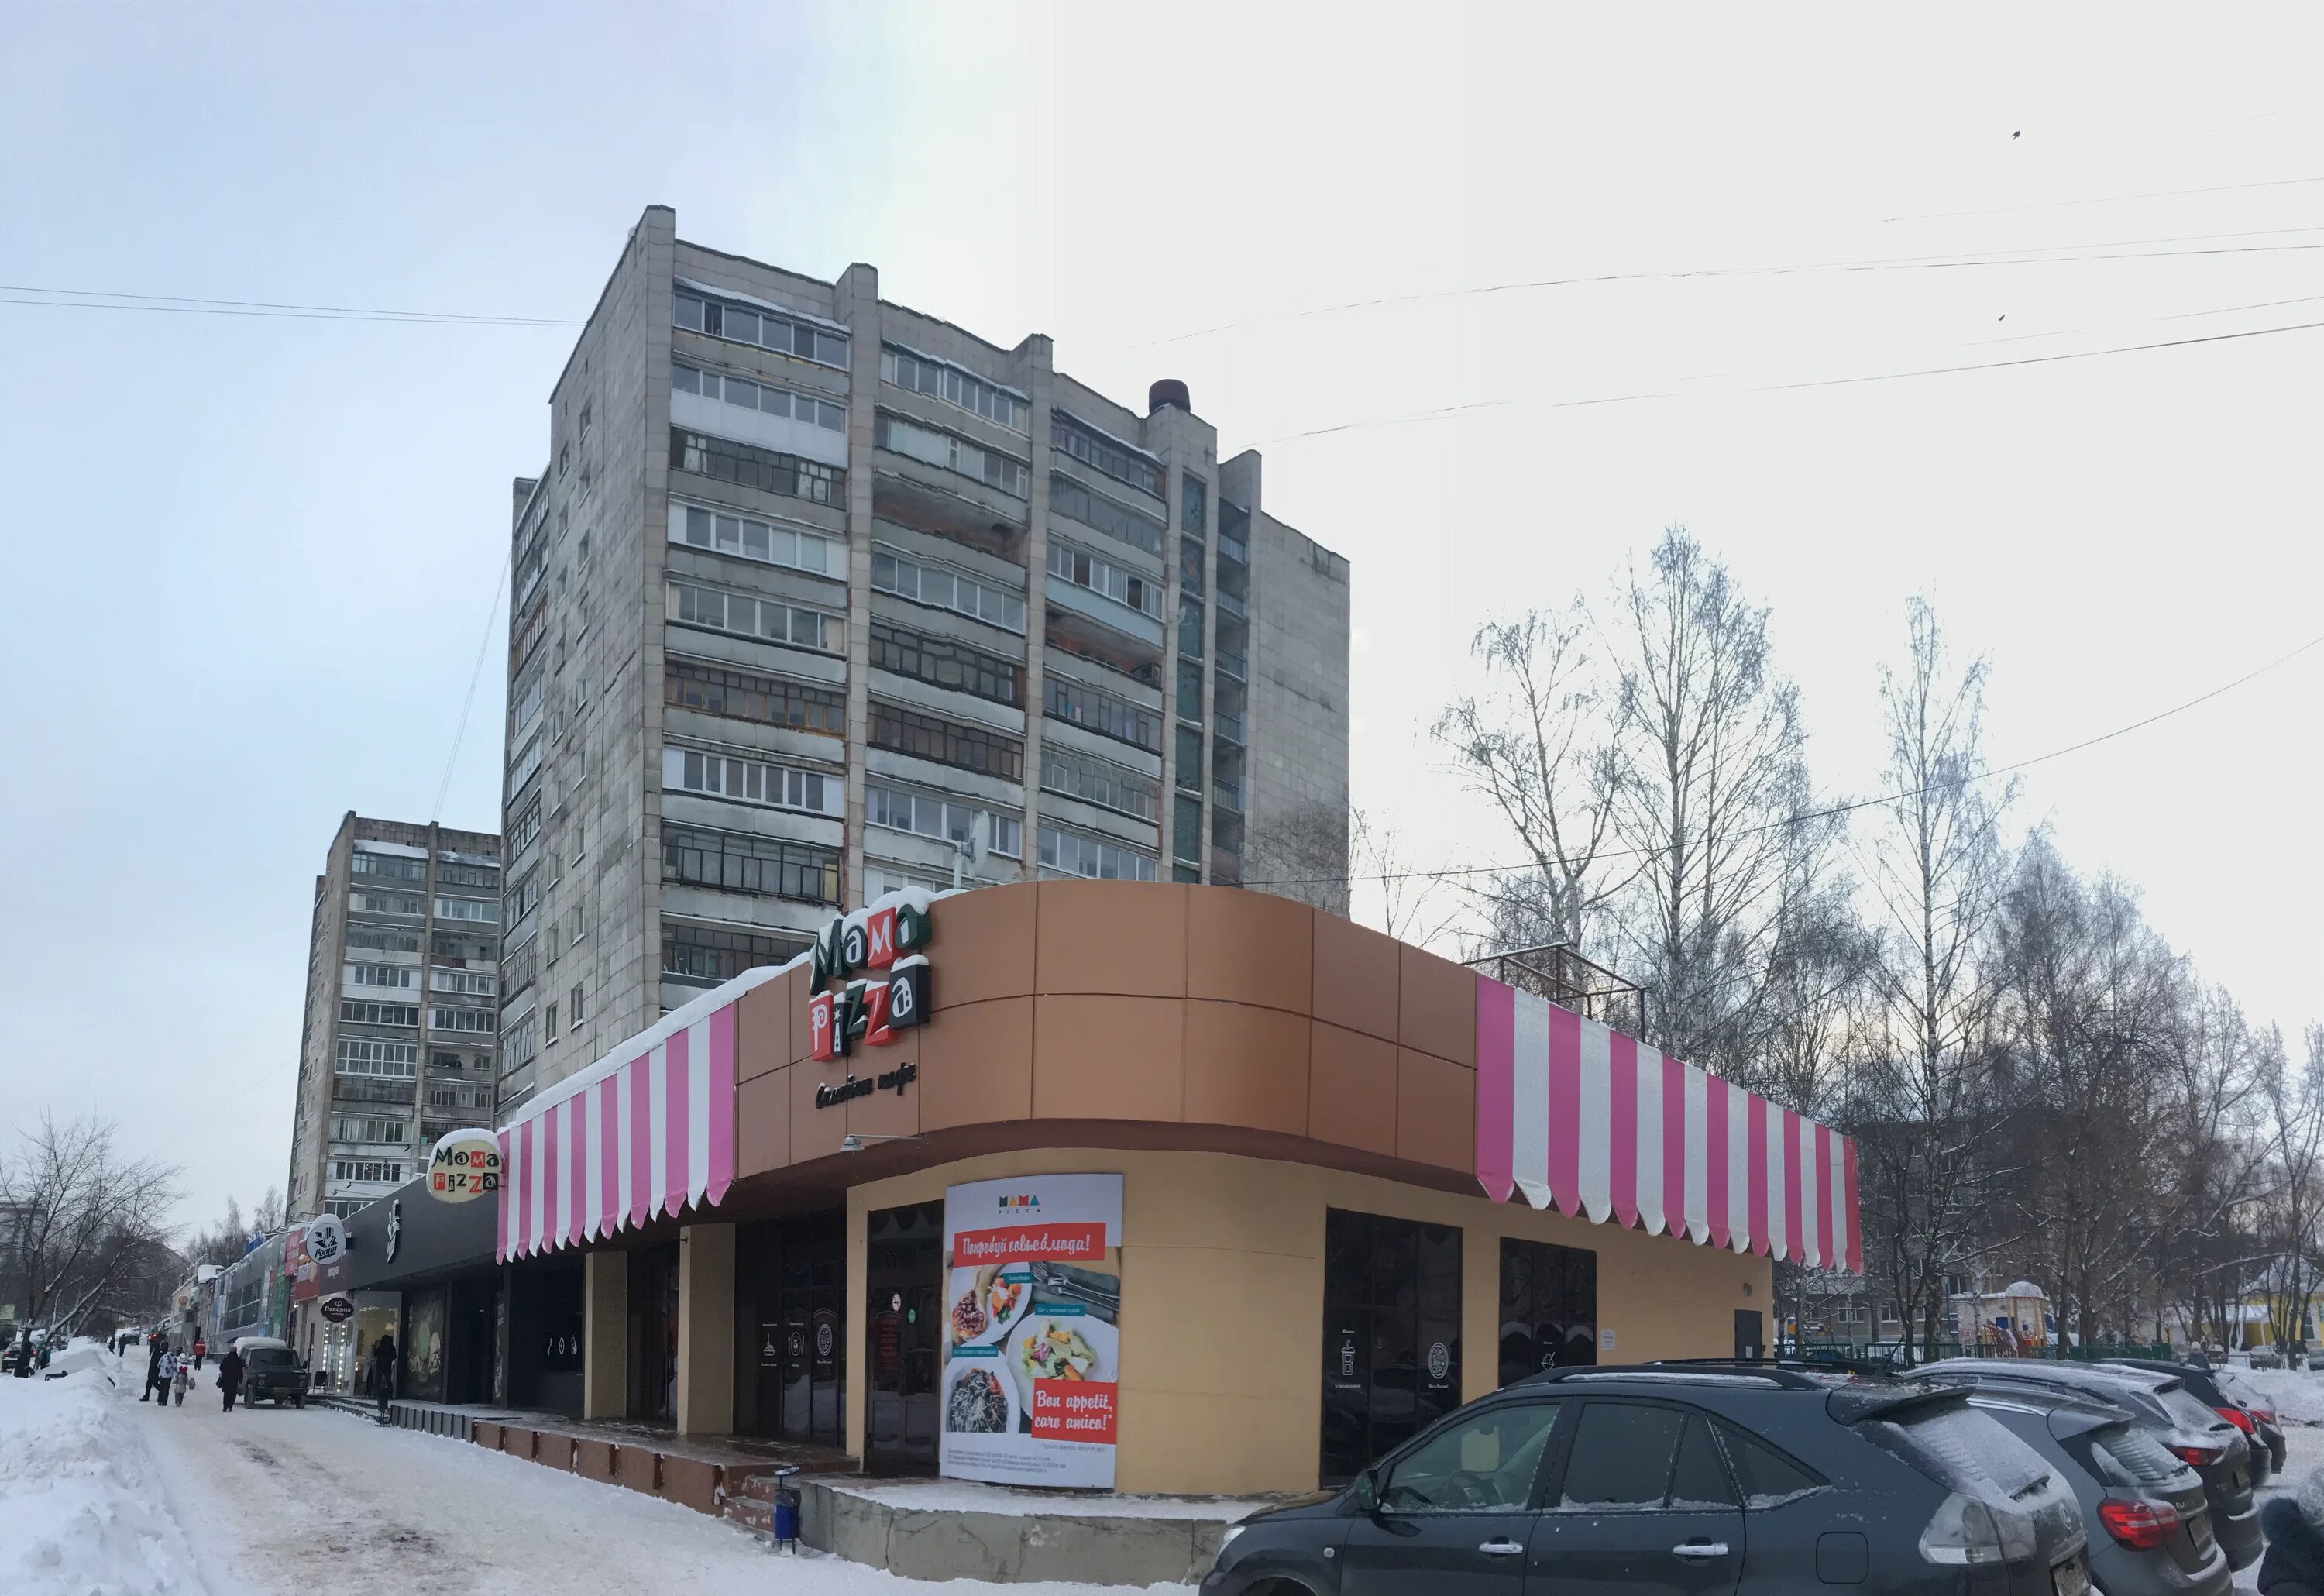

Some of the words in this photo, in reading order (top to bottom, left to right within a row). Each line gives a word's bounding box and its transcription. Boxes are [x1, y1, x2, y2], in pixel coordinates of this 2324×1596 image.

[962, 1236, 1008, 1257] Попробуй
[1009, 1234, 1039, 1252] новые
[1040, 1233, 1091, 1256] блюда!
[1036, 1390, 1061, 1407] Bon
[1066, 1394, 1112, 1412] appetit,
[1035, 1416, 1061, 1429] caro
